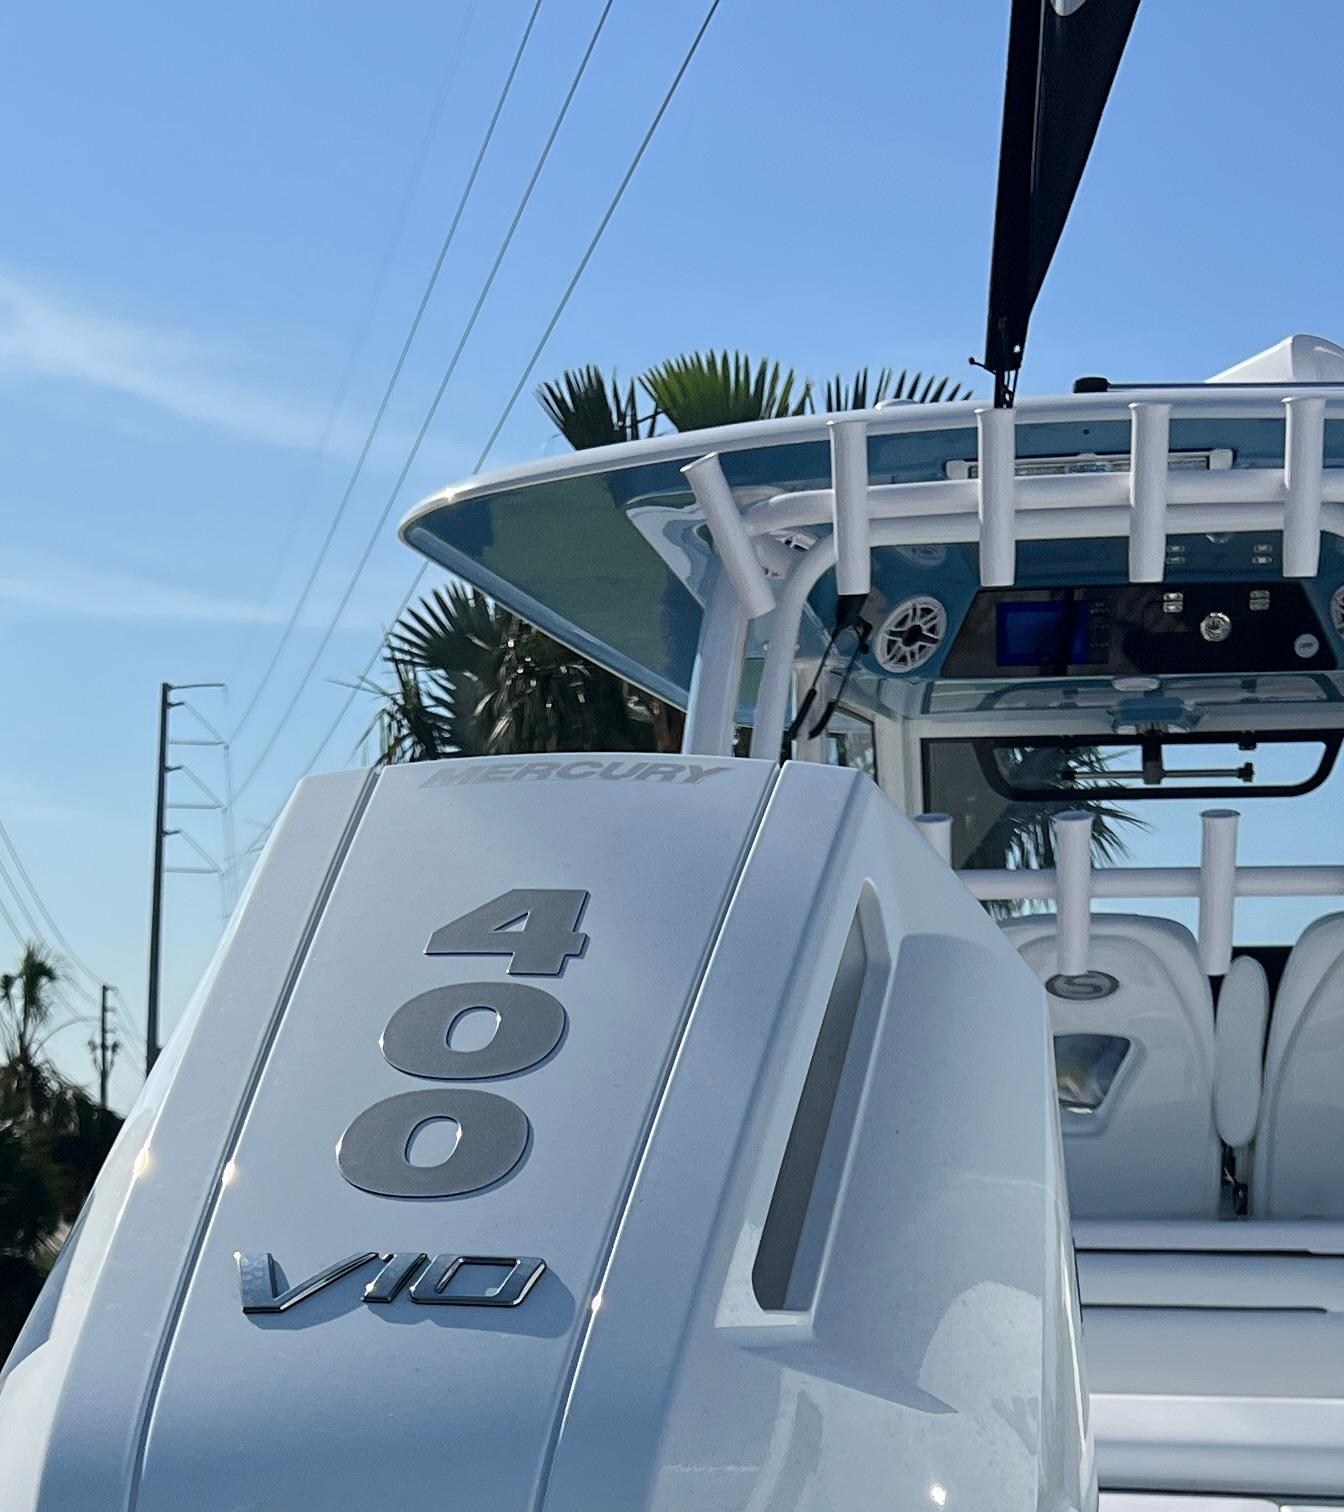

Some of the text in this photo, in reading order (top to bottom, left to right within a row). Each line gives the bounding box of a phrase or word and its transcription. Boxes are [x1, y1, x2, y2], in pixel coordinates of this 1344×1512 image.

[419, 761, 732, 788] MERCURY
[336, 889, 590, 1199] 400
[234, 1251, 546, 1313] V10
